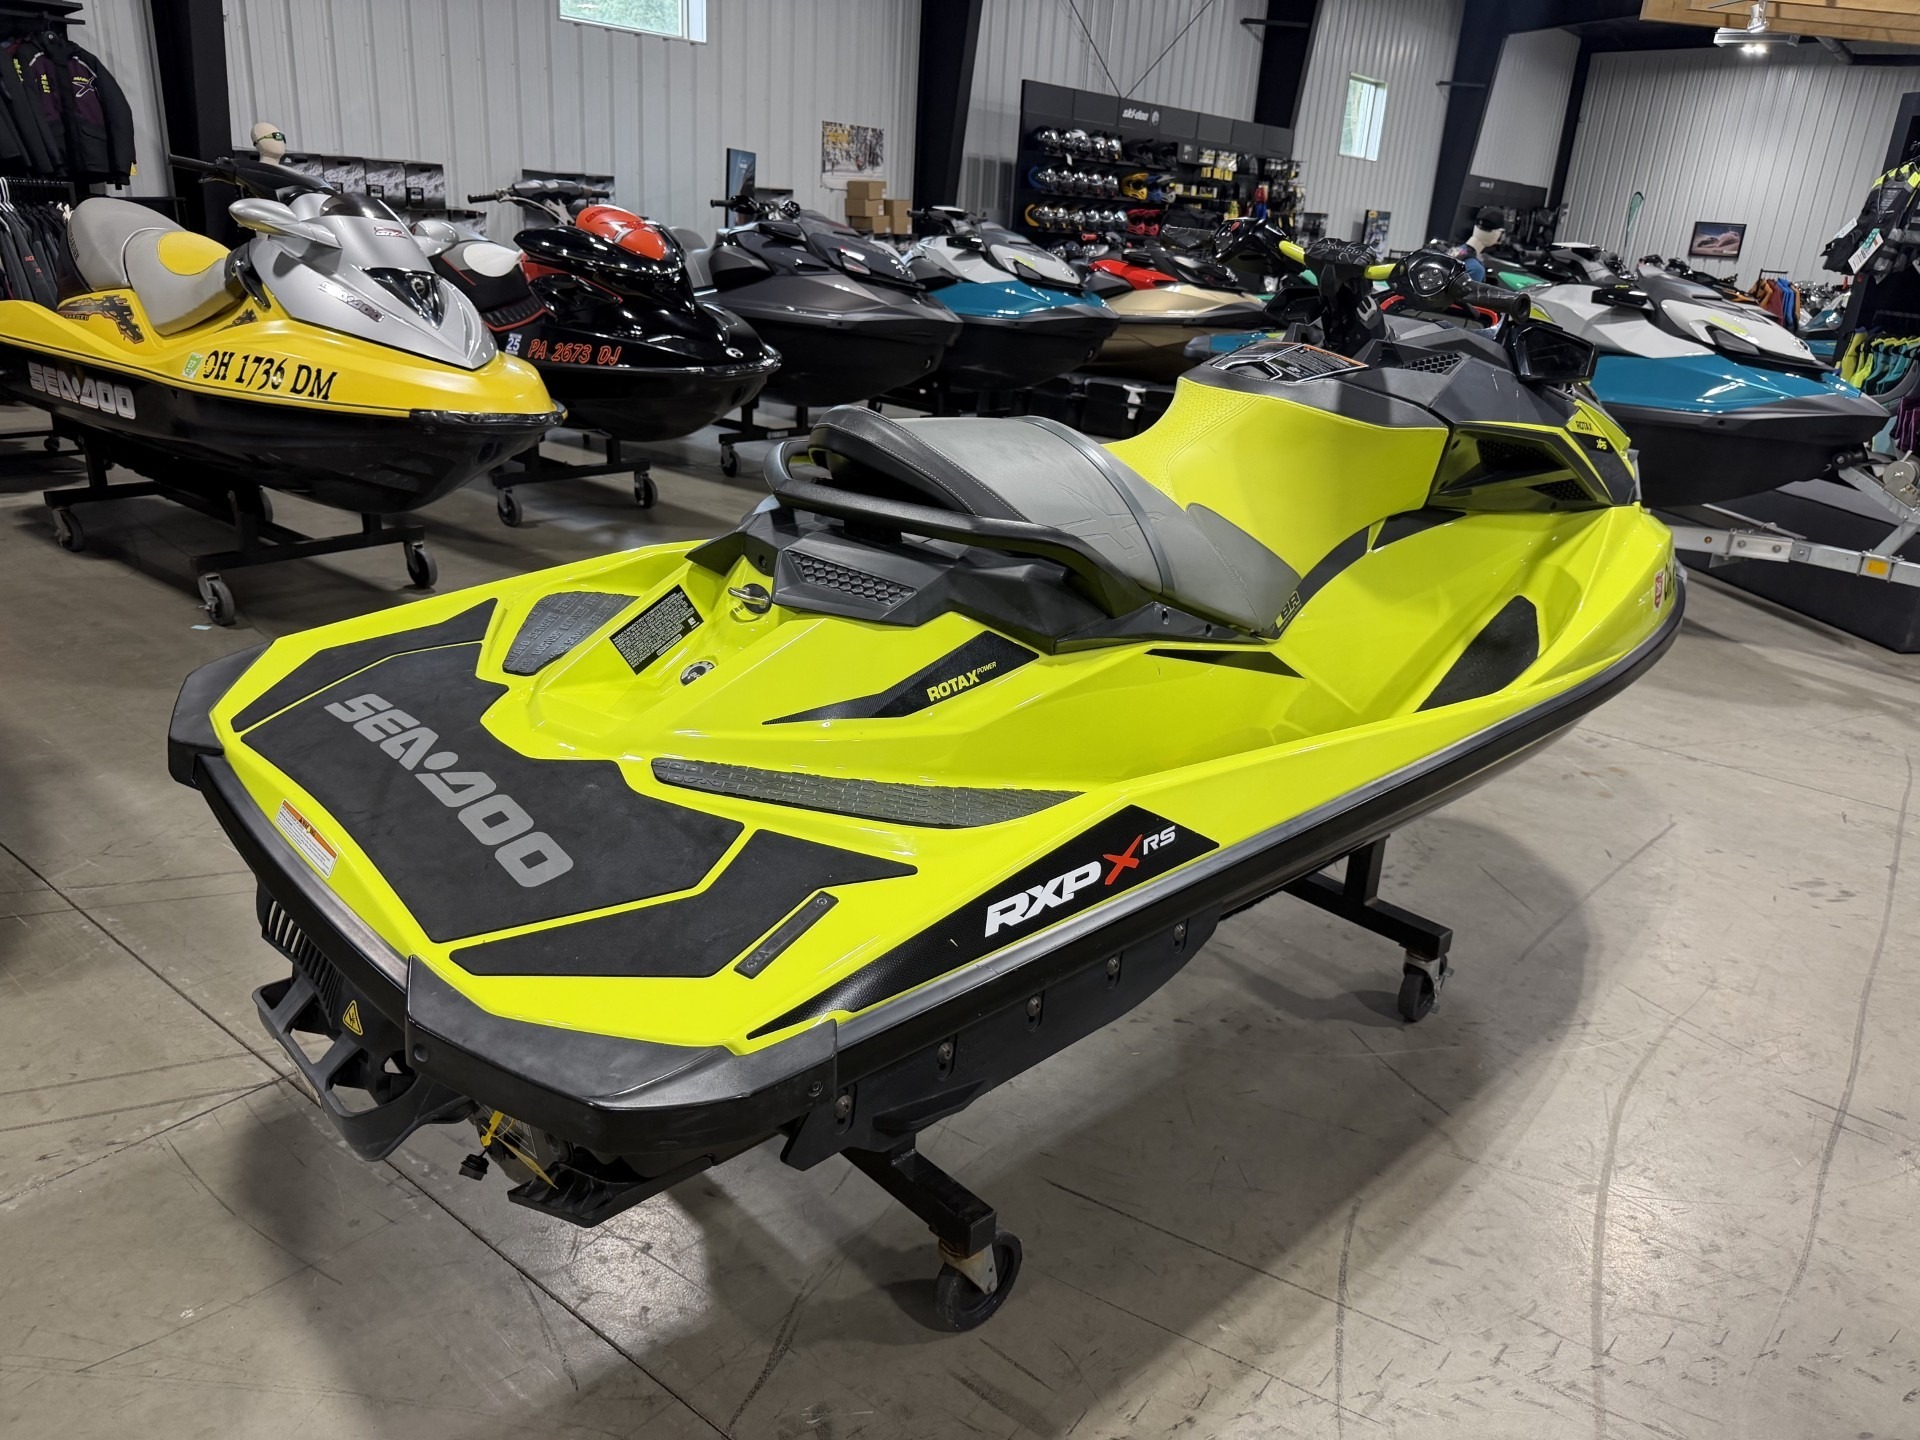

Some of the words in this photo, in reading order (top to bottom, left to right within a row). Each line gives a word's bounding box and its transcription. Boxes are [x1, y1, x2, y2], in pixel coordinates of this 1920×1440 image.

[527, 338, 548, 360] PA
[551, 342, 593, 364] 2673
[597, 345, 622, 366] DJ
[202, 350, 235, 381] OH
[235, 354, 289, 390] 1736
[290, 364, 338, 400] DM
[926, 669, 980, 702] ROTAX
[976, 661, 997, 674] POWER
[1143, 825, 1176, 855] RS
